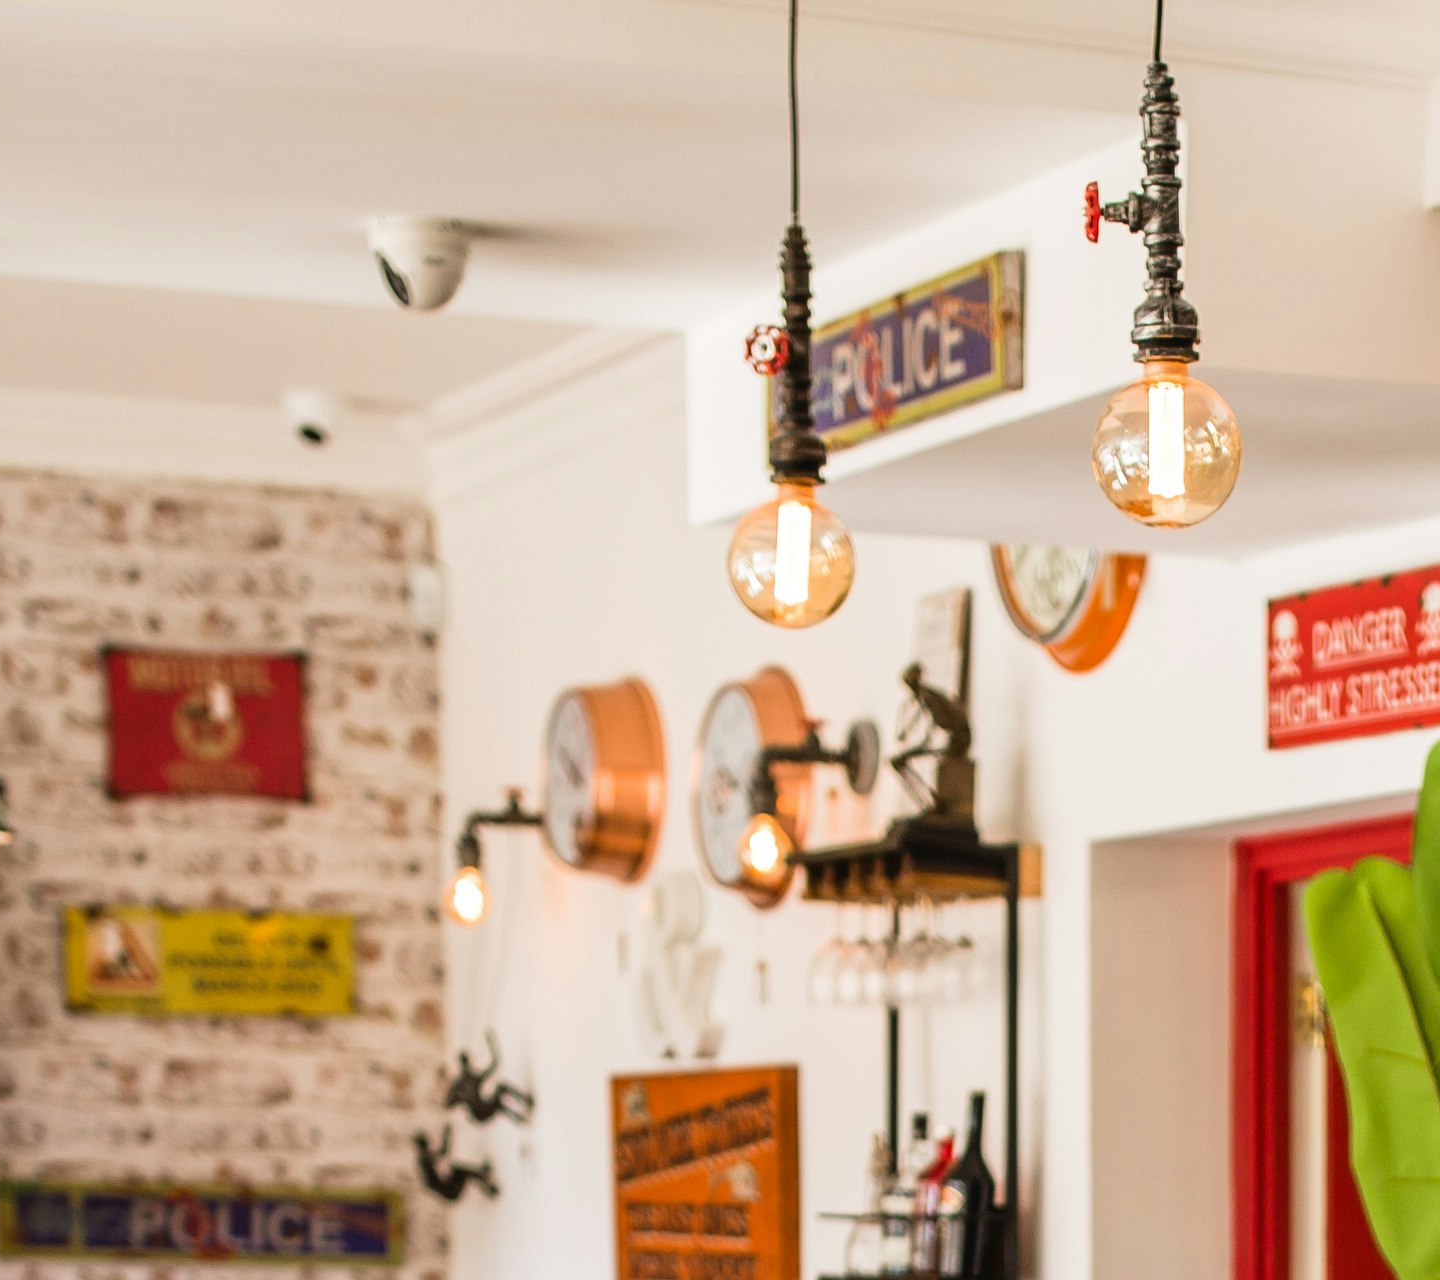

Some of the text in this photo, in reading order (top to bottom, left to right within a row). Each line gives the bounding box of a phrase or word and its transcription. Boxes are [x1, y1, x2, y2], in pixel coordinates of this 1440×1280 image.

[830, 299, 967, 422] POLICE
[1312, 606, 1409, 661] DANGER
[1268, 676, 1344, 729] HIGHLY
[130, 1198, 348, 1254] POLICE
